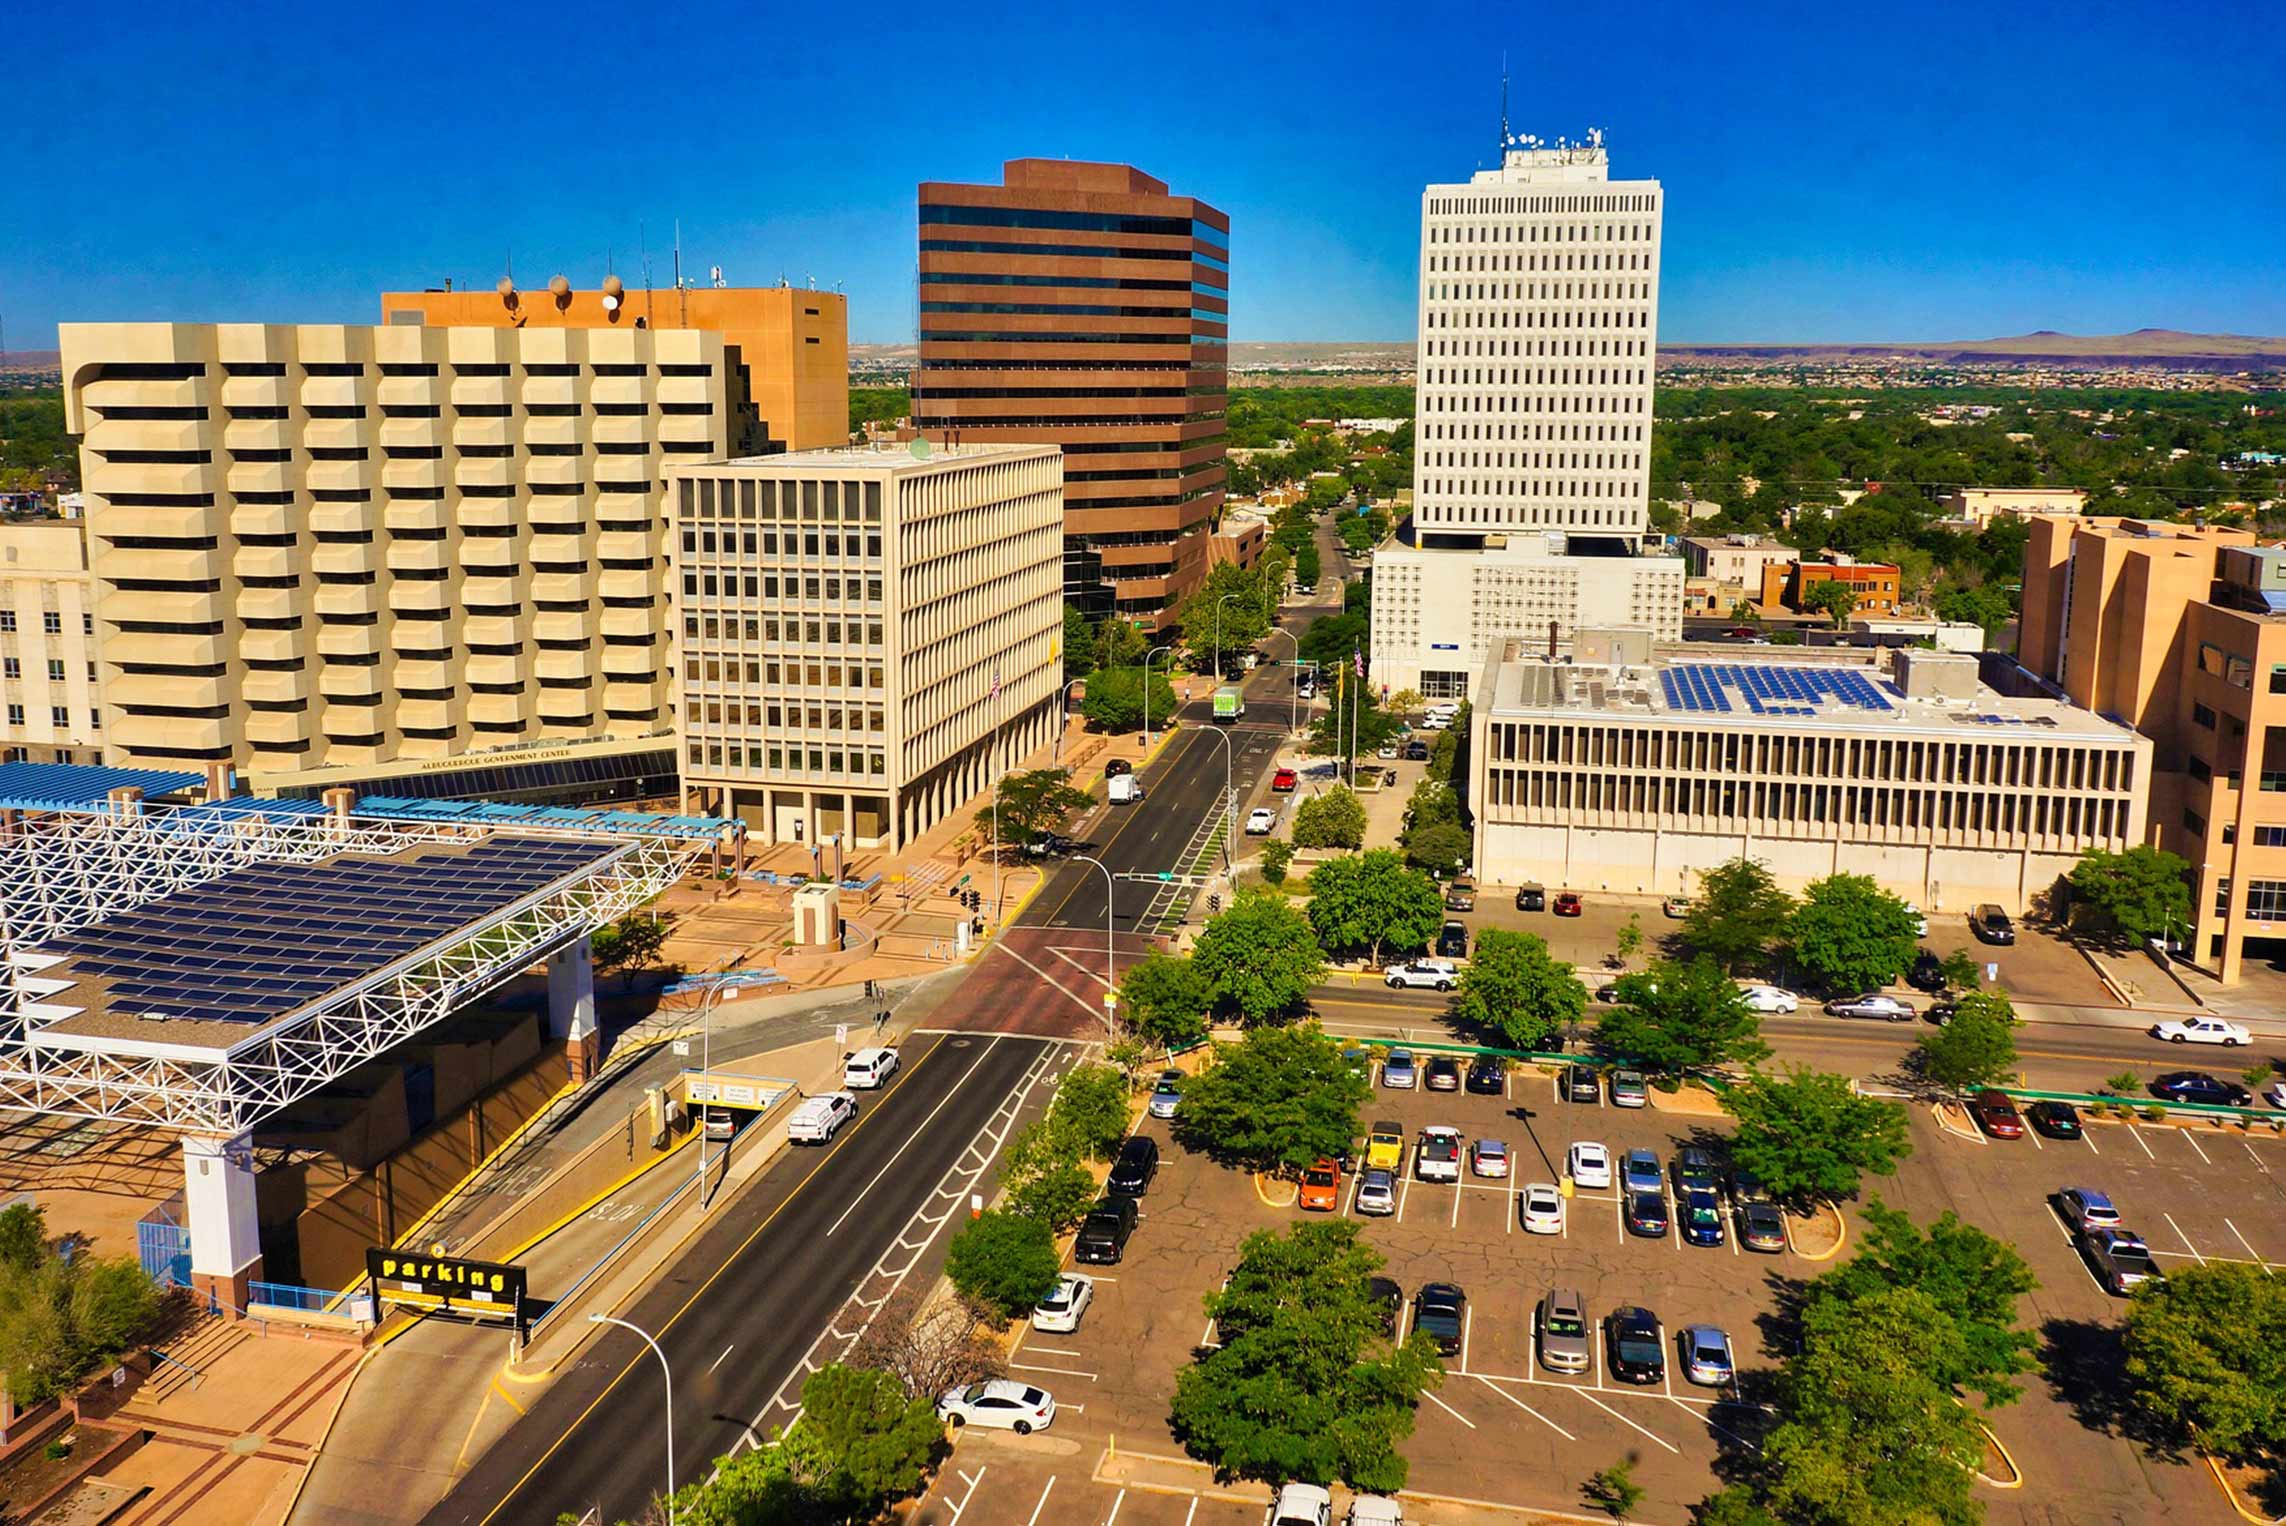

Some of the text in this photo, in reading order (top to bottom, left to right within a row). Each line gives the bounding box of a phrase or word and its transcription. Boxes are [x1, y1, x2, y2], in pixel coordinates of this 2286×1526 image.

[422, 749, 570, 769] ALBUQUERQUE GOVERNMENT CENTER
[588, 1202, 645, 1223] SLOW
[382, 1259, 504, 1292] parking
